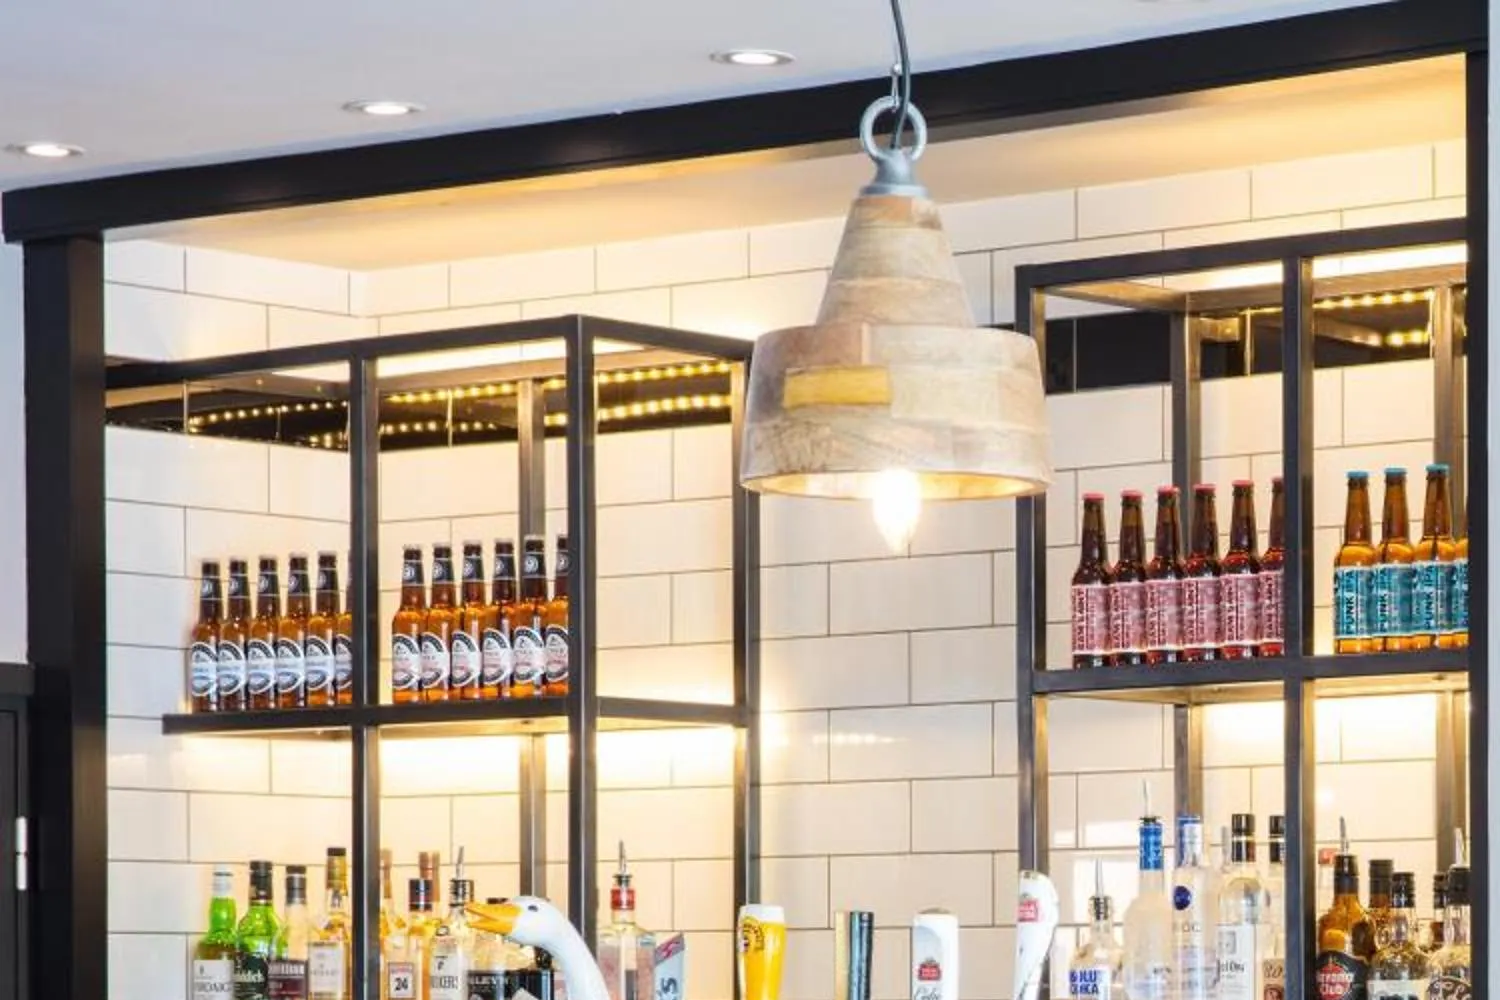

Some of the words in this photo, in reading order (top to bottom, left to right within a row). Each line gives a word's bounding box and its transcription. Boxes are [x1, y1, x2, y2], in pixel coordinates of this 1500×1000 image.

[1345, 595, 1355, 635] PUNK
[1379, 593, 1388, 633] PUNK
[1425, 590, 1434, 629] PUNK
[395, 977, 409, 991] 24
